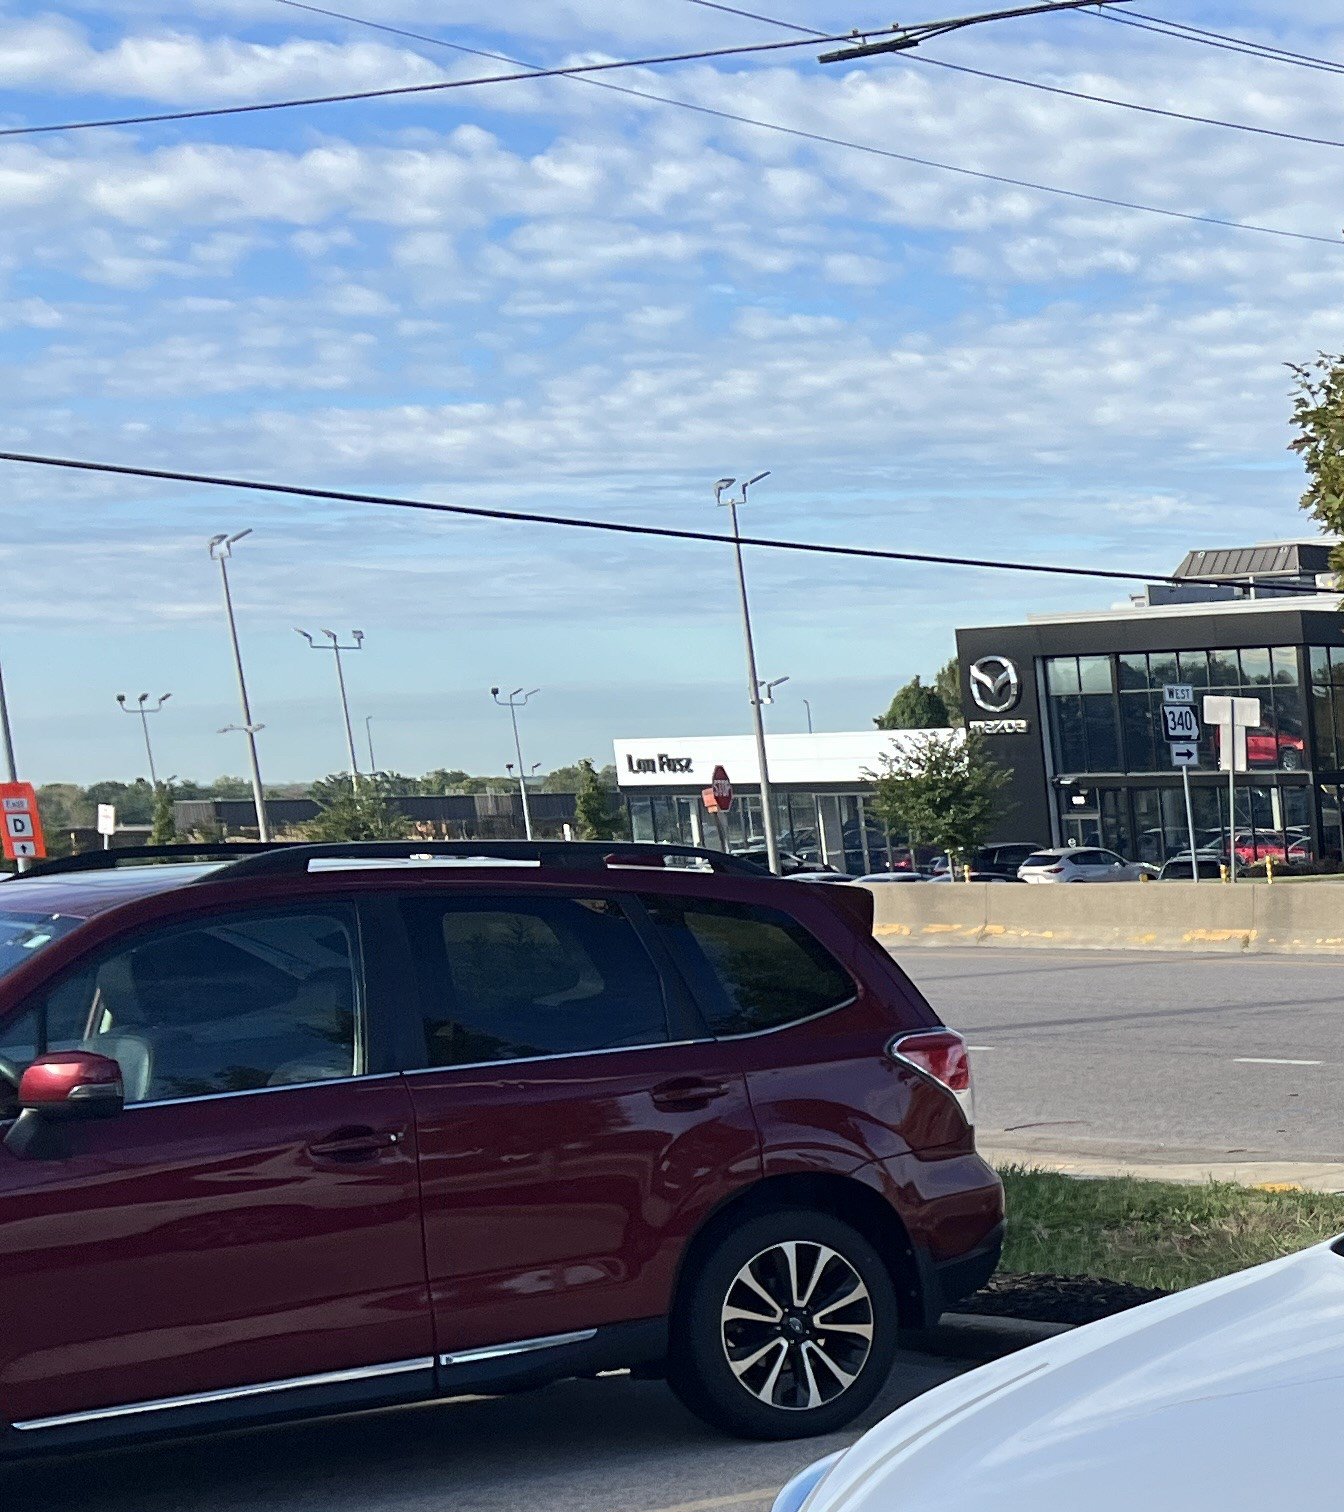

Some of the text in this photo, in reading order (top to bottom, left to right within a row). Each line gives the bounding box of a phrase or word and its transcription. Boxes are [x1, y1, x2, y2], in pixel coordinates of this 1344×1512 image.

[1167, 687, 1190, 699] WEST
[1168, 710, 1192, 731] 340
[13, 818, 26, 832] D
